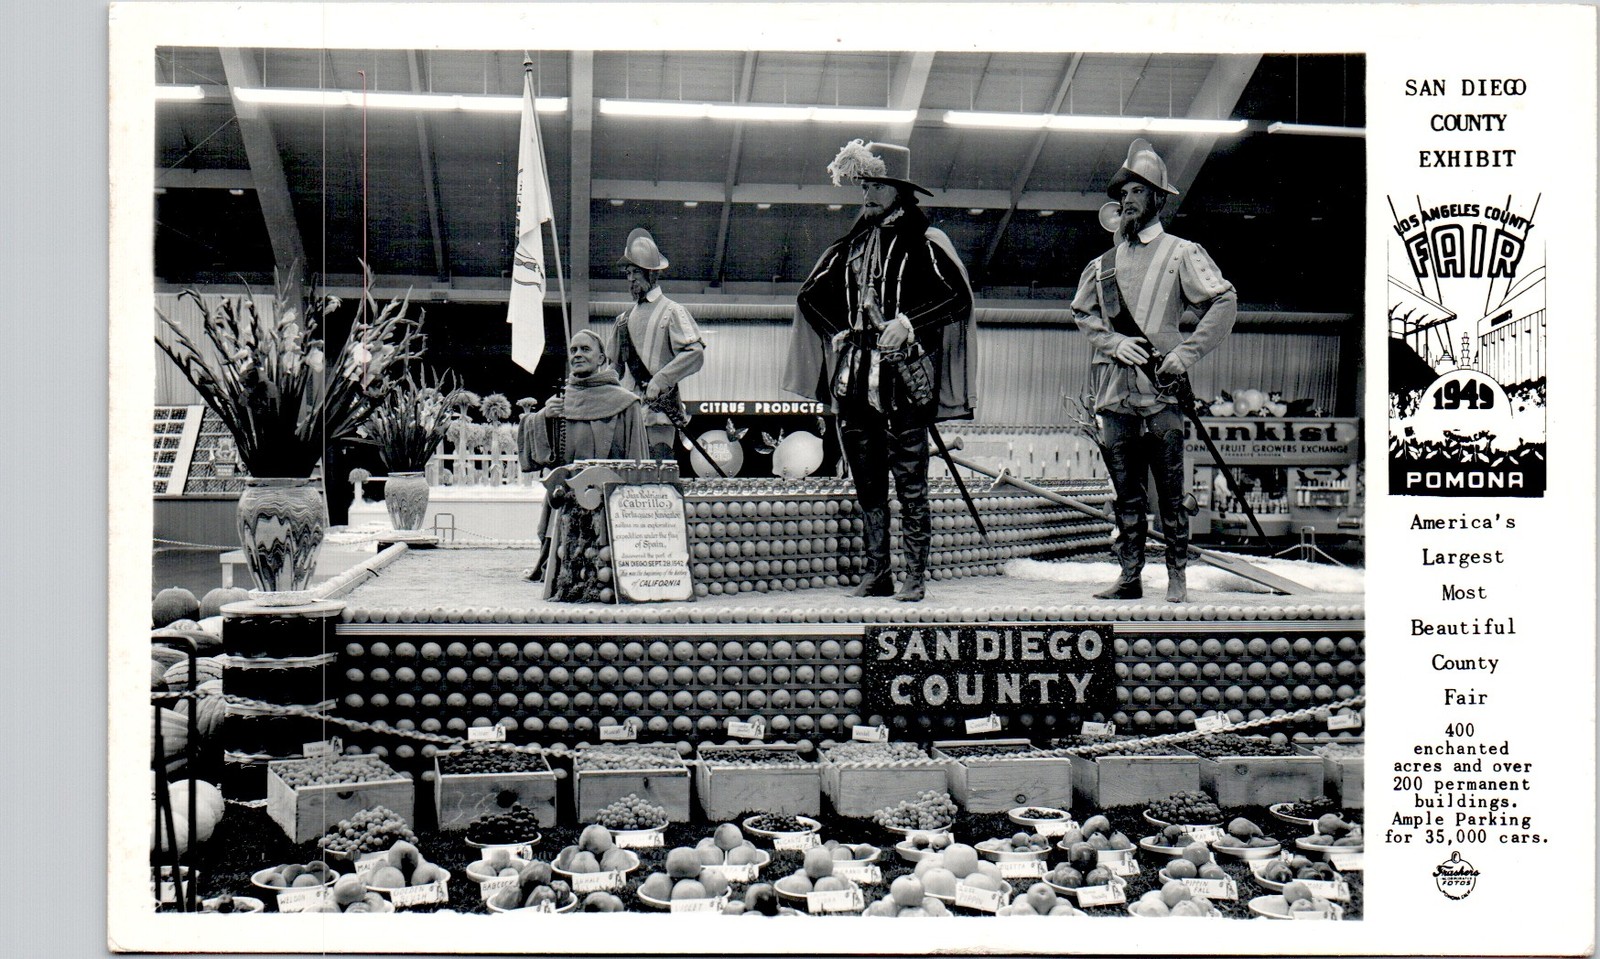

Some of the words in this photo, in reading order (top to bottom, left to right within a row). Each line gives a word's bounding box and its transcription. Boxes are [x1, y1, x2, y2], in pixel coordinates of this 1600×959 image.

[699, 402, 745, 413] CITRUS
[755, 402, 824, 414] PRODUCTS
[1220, 444, 1246, 453] FRUIT
[1252, 444, 1297, 454] GROWERS
[1301, 445, 1348, 454] EXCHANGE
[635, 541, 643, 551] of
[639, 579, 681, 588] CALIFORNIA
[876, 629, 961, 661] SAN
[975, 629, 1103, 661] DIEGO
[890, 673, 1094, 707] COUNTY
